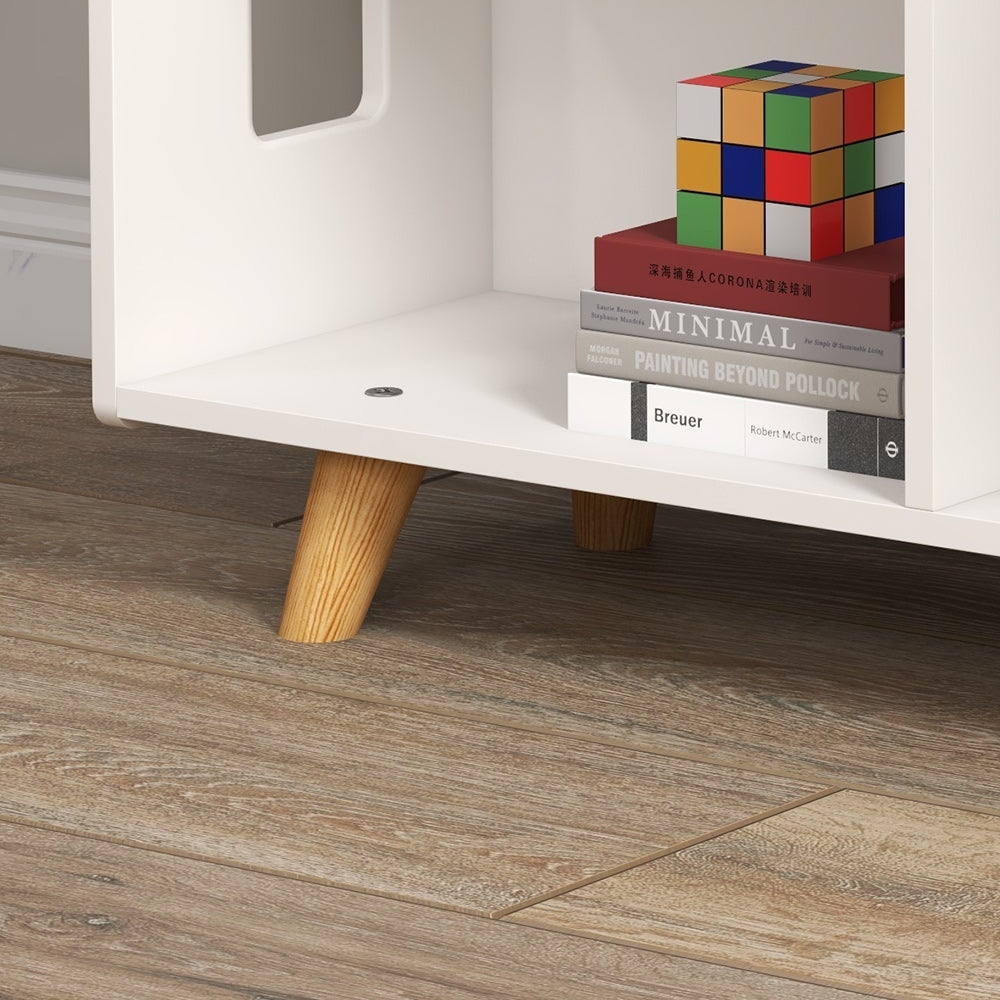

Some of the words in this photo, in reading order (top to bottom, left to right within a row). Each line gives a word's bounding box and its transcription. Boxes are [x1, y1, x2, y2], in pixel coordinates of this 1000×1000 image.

[648, 308, 797, 350] MINIMAL
[814, 339, 831, 348] Simple
[635, 350, 709, 380] PAINTING
[714, 361, 781, 391] BEYOND
[785, 371, 861, 402] POLLOCK
[654, 407, 703, 429] Breuer
[750, 424, 780, 440] Robert
[782, 429, 823, 445] McCarter
